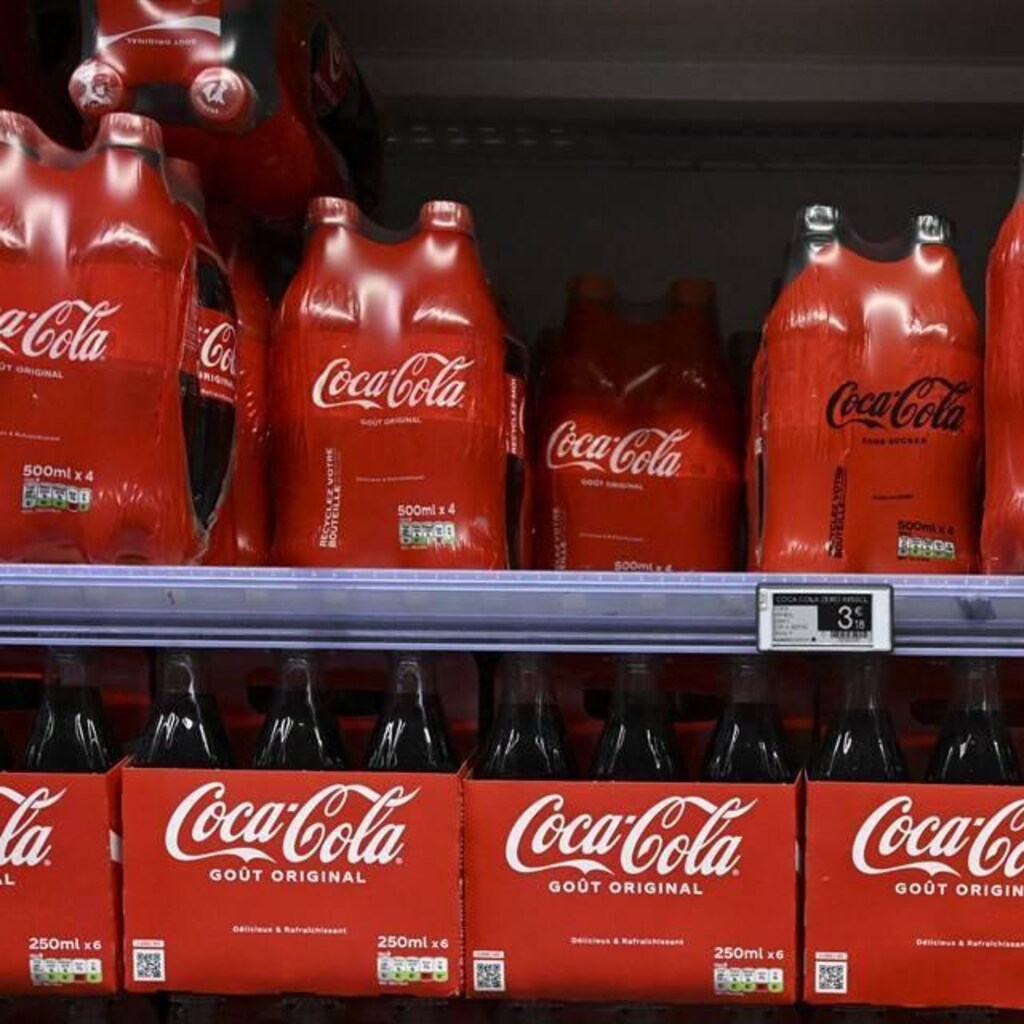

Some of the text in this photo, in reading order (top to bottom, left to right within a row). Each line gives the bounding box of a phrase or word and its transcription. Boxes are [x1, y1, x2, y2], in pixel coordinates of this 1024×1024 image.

[312, 352, 475, 409] Coca-Cola
[826, 376, 973, 431] Coca-Cola
[547, 420, 691, 478] Coca-Cola
[23, 464, 94, 482] 500ml 4
[325, 448, 334, 485] VOTRE
[398, 503, 456, 516] 500ml 4
[898, 520, 934, 533] 500ml
[837, 605, 853, 630] 3
[165, 781, 421, 864] Coca-Cola
[505, 794, 758, 876] Coca-Cola
[209, 867, 367, 884] GOÛT ORIGINAL
[549, 878, 703, 896] GOÛT ORIGINAL
[895, 880, 947, 895] GOÛT
[29, 938, 80, 951] 250ml
[377, 935, 428, 949] 250ml
[714, 946, 763, 959] 250ml
